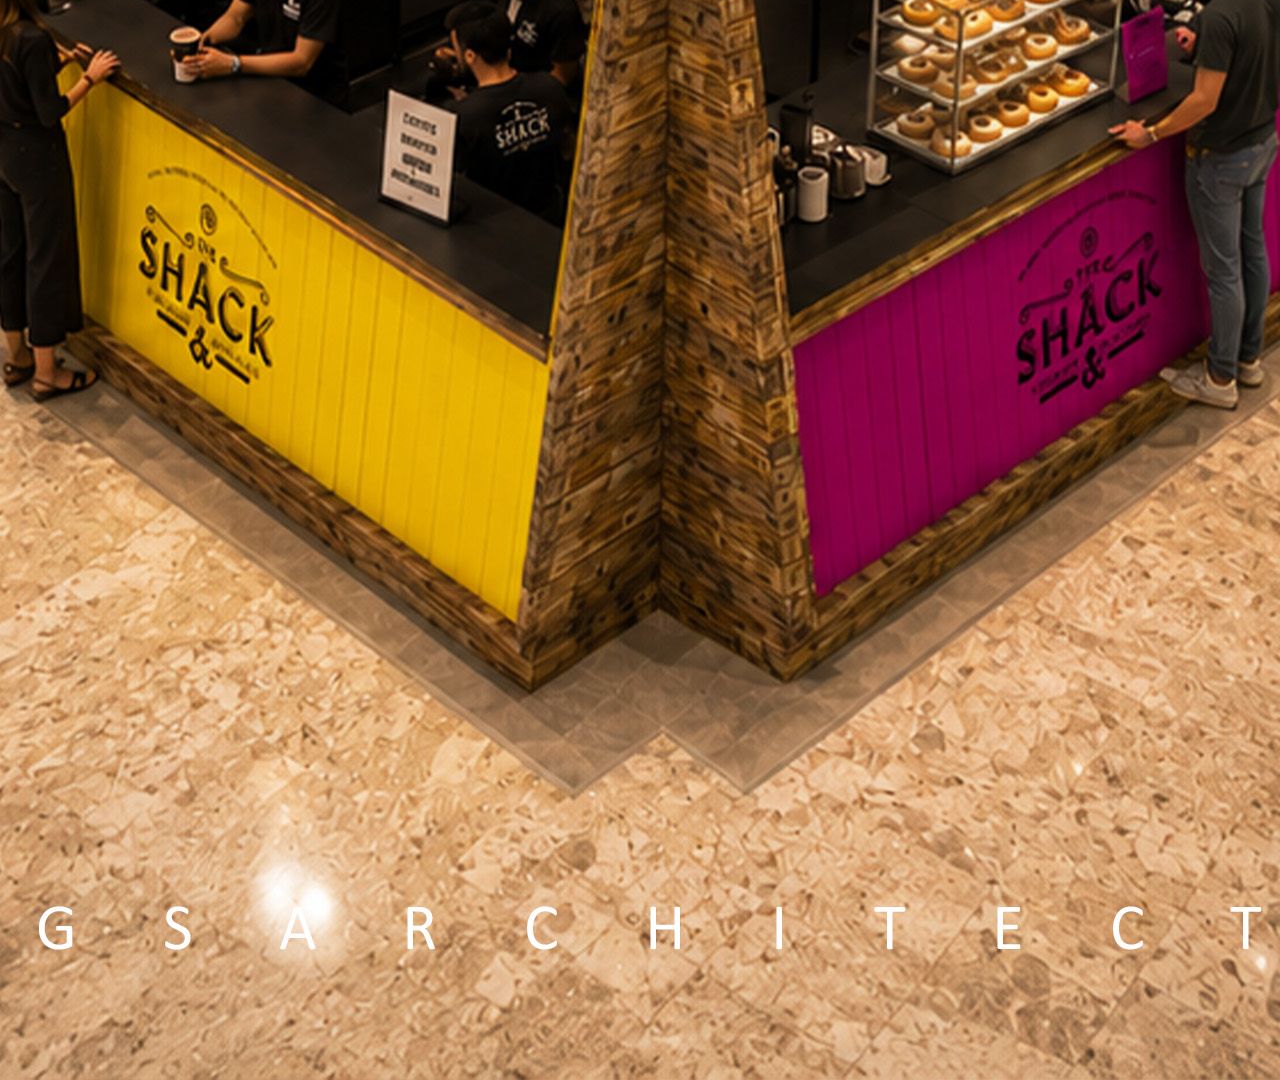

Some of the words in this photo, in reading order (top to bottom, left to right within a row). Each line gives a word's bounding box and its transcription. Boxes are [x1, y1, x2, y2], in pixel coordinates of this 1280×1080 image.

[495, 113, 551, 150] SHACK
[138, 225, 276, 368] SHACK
[1016, 249, 1162, 385] SHACK
[1081, 346, 1106, 390] &
